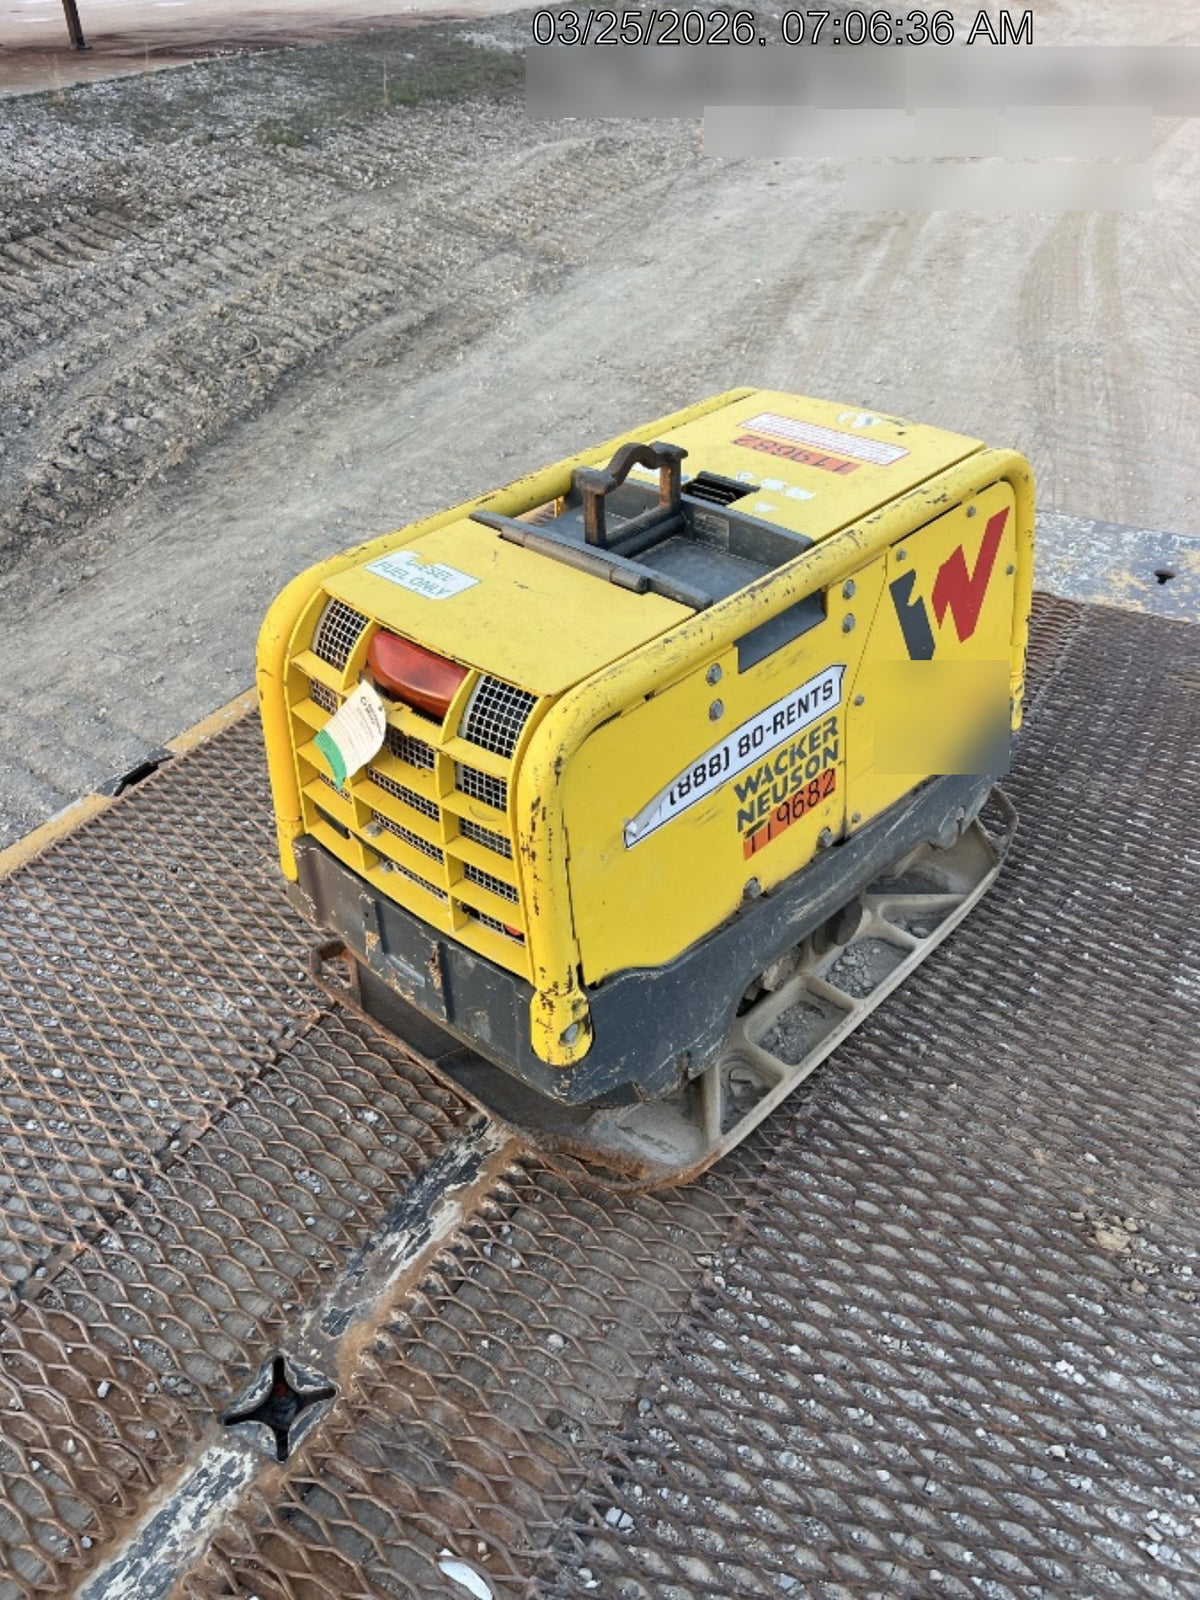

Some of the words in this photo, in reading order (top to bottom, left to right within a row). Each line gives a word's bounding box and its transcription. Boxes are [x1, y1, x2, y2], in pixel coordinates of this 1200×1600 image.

[370, 561, 411, 580] FUEL
[409, 577, 451, 596] ONLY
[669, 746, 730, 806] (888)
[737, 679, 834, 758] 80-RENTS
[733, 715, 839, 804] WACKER
[736, 739, 839, 834] NEUSON
